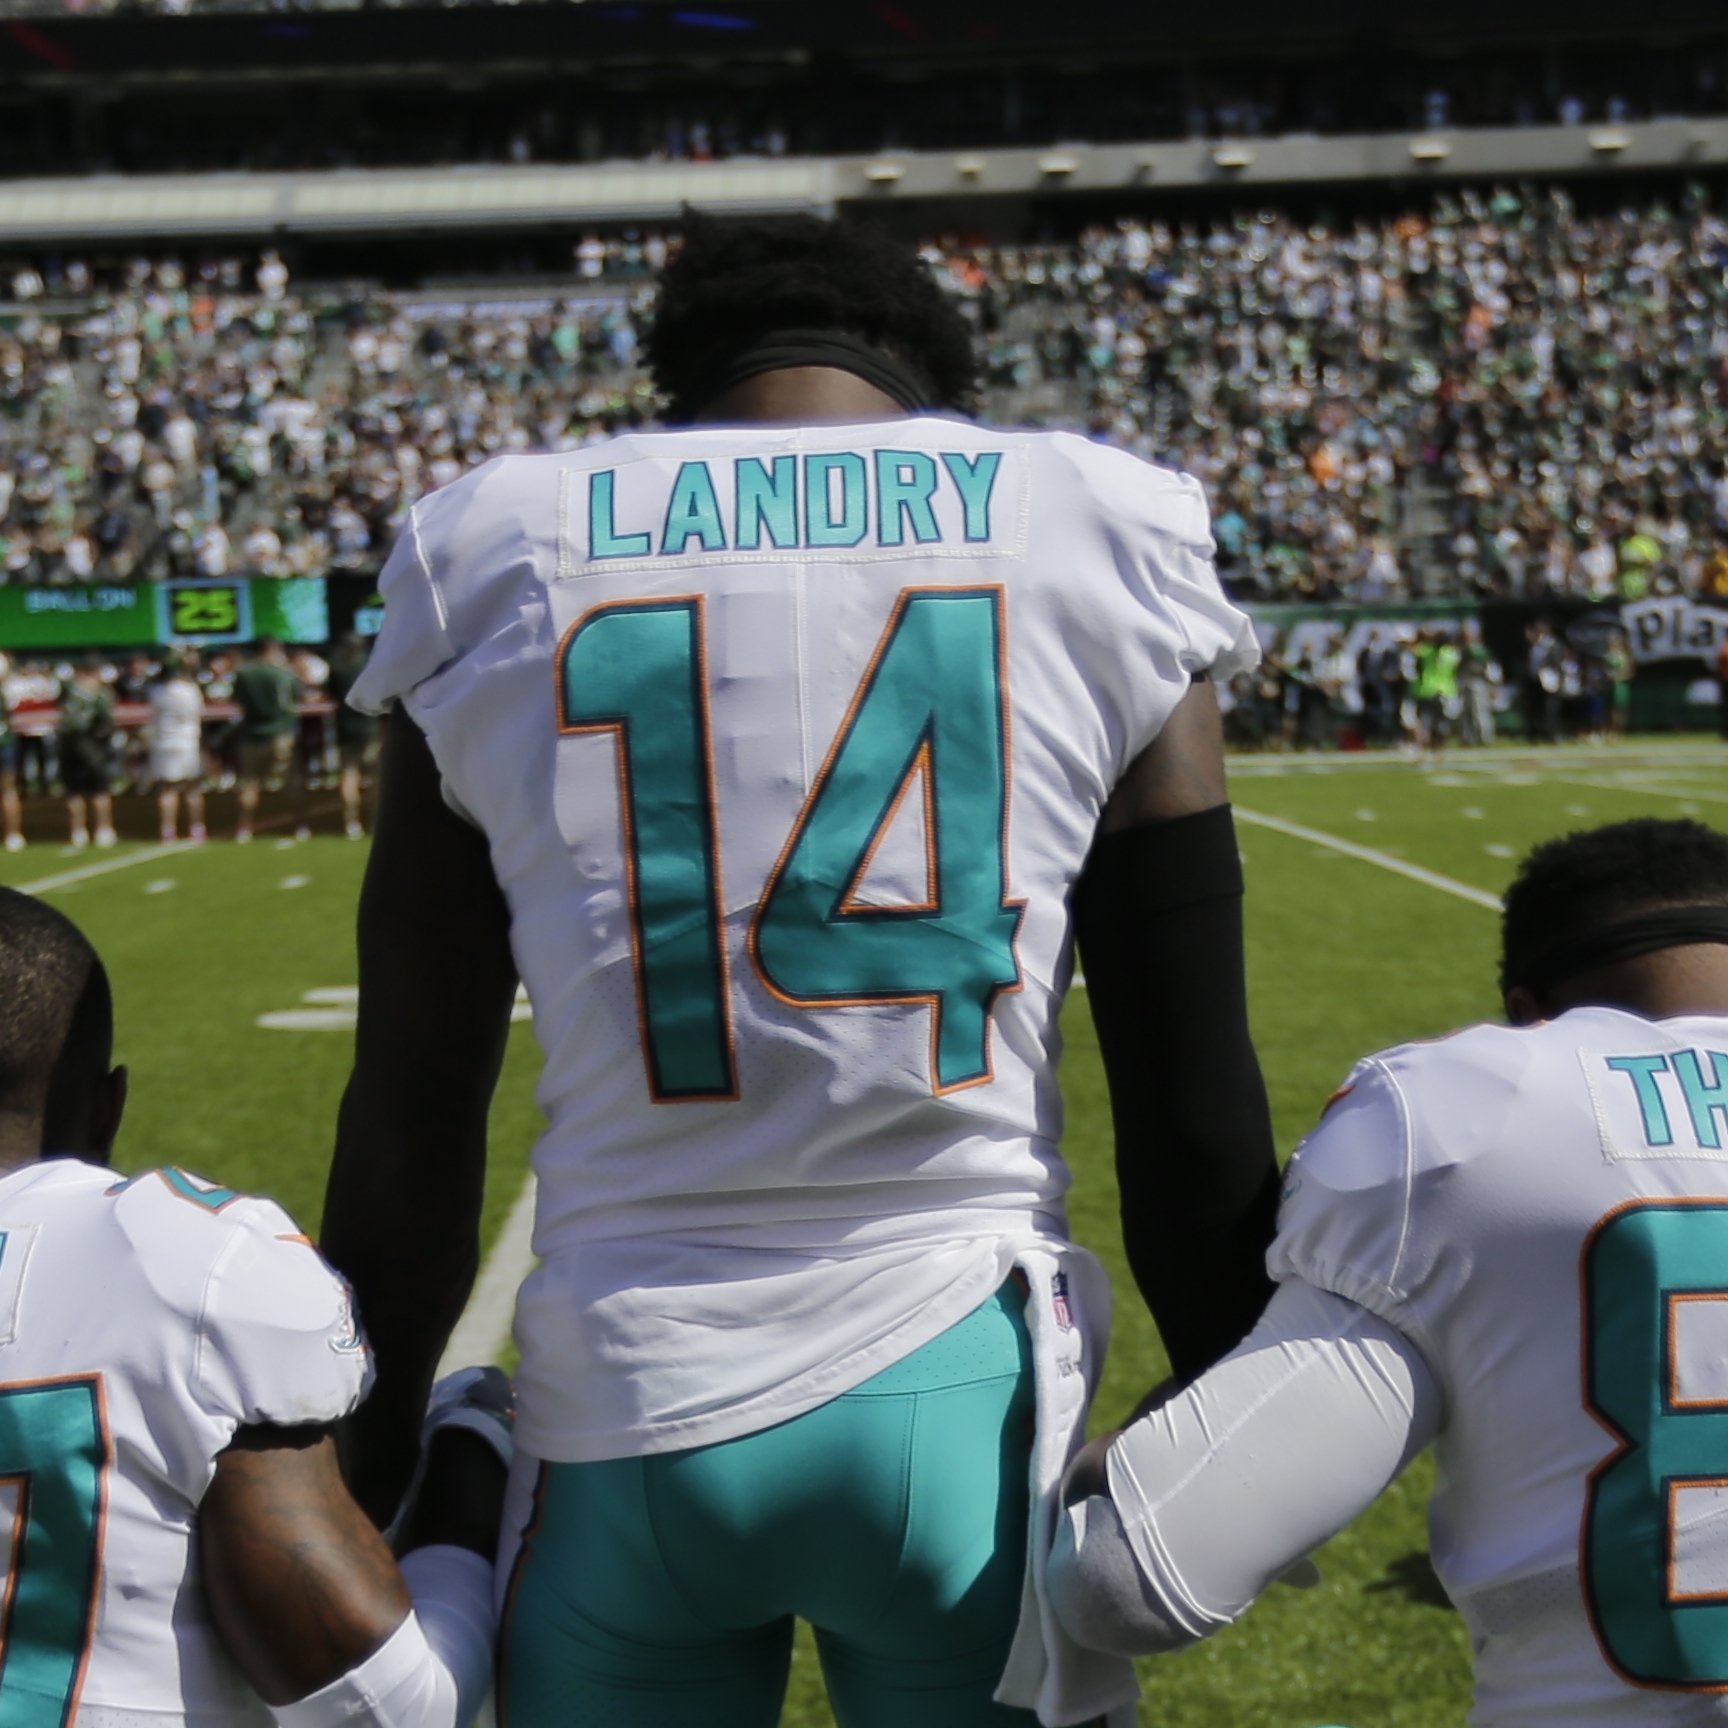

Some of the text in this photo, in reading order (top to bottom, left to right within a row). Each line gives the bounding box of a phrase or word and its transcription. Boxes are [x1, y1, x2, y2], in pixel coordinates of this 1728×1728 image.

[587, 447, 1003, 562] LANDRY
[175, 590, 238, 631] 25
[554, 582, 1028, 1105] 14
